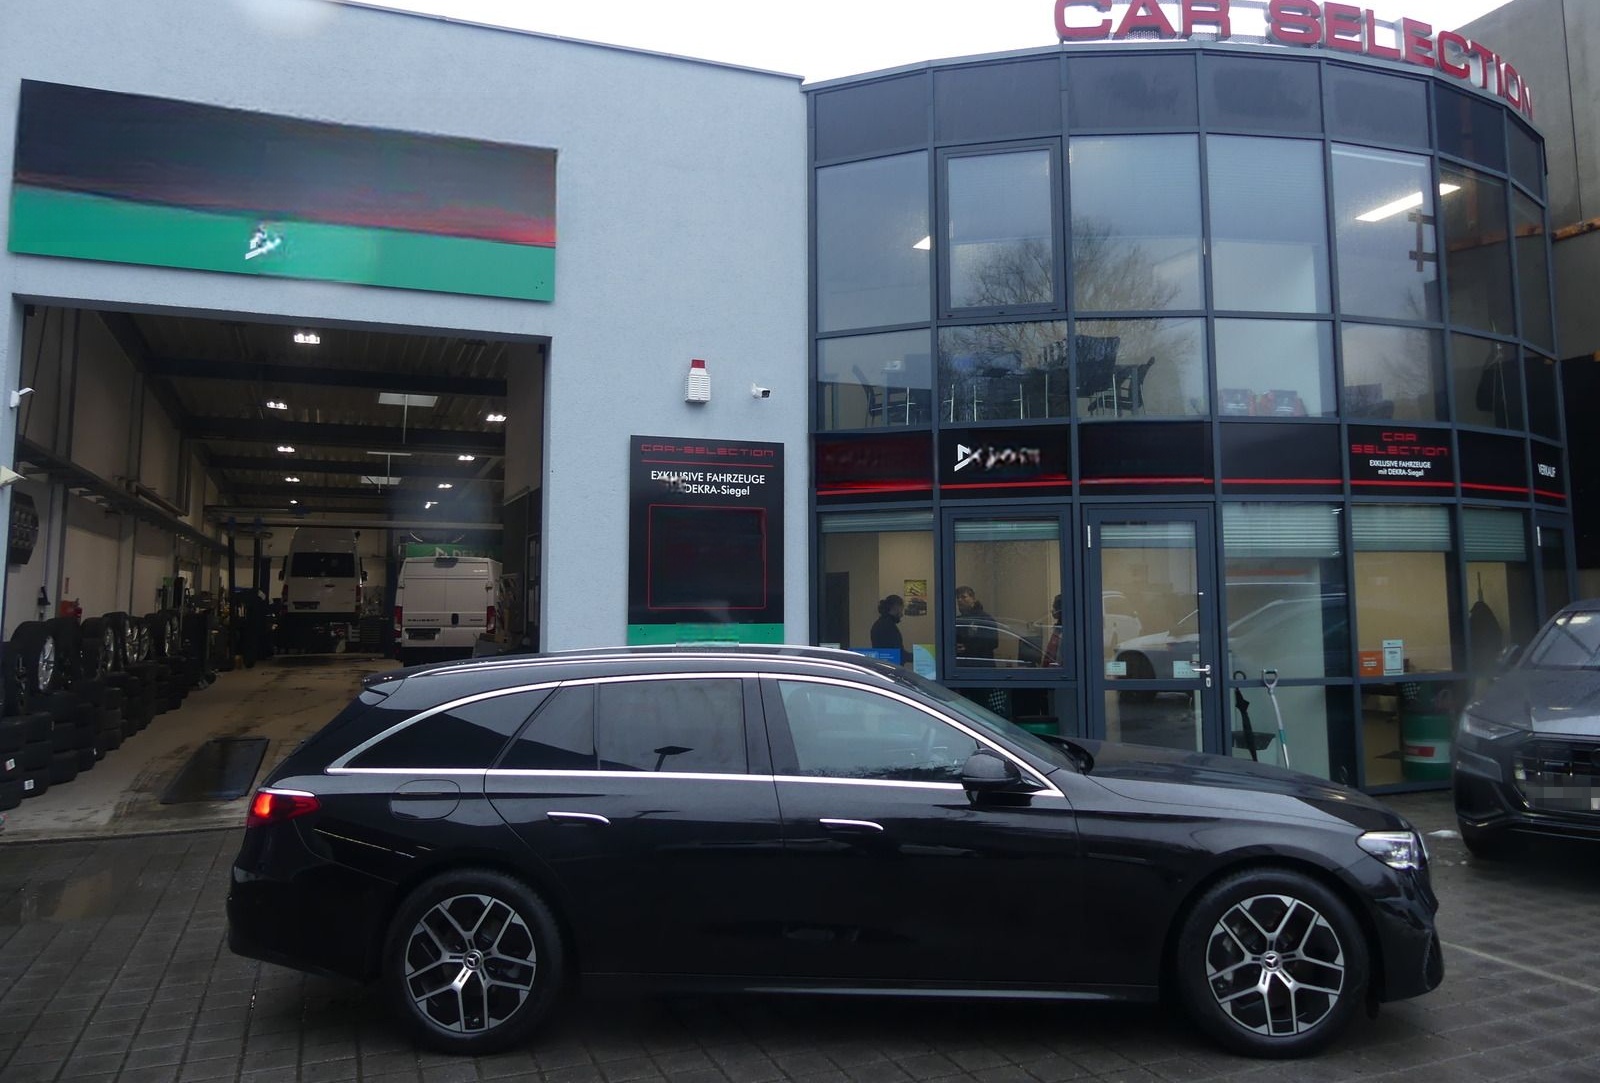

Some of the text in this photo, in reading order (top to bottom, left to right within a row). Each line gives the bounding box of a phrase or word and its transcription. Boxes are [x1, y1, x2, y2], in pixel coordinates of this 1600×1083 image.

[1054, 0, 1533, 120] CAR SELECTION
[1382, 432, 1418, 442] CAR
[640, 444, 774, 458] CAR-SELECTION
[1351, 444, 1448, 456] SELECTION
[1369, 459, 1432, 469] EXKLUSIVE FAHRZEUGE
[706, 472, 766, 485] FAHRZEUGE
[1388, 468, 1425, 478] DEKRA-Siegel
[685, 483, 750, 498] DEKRA-Siegel
